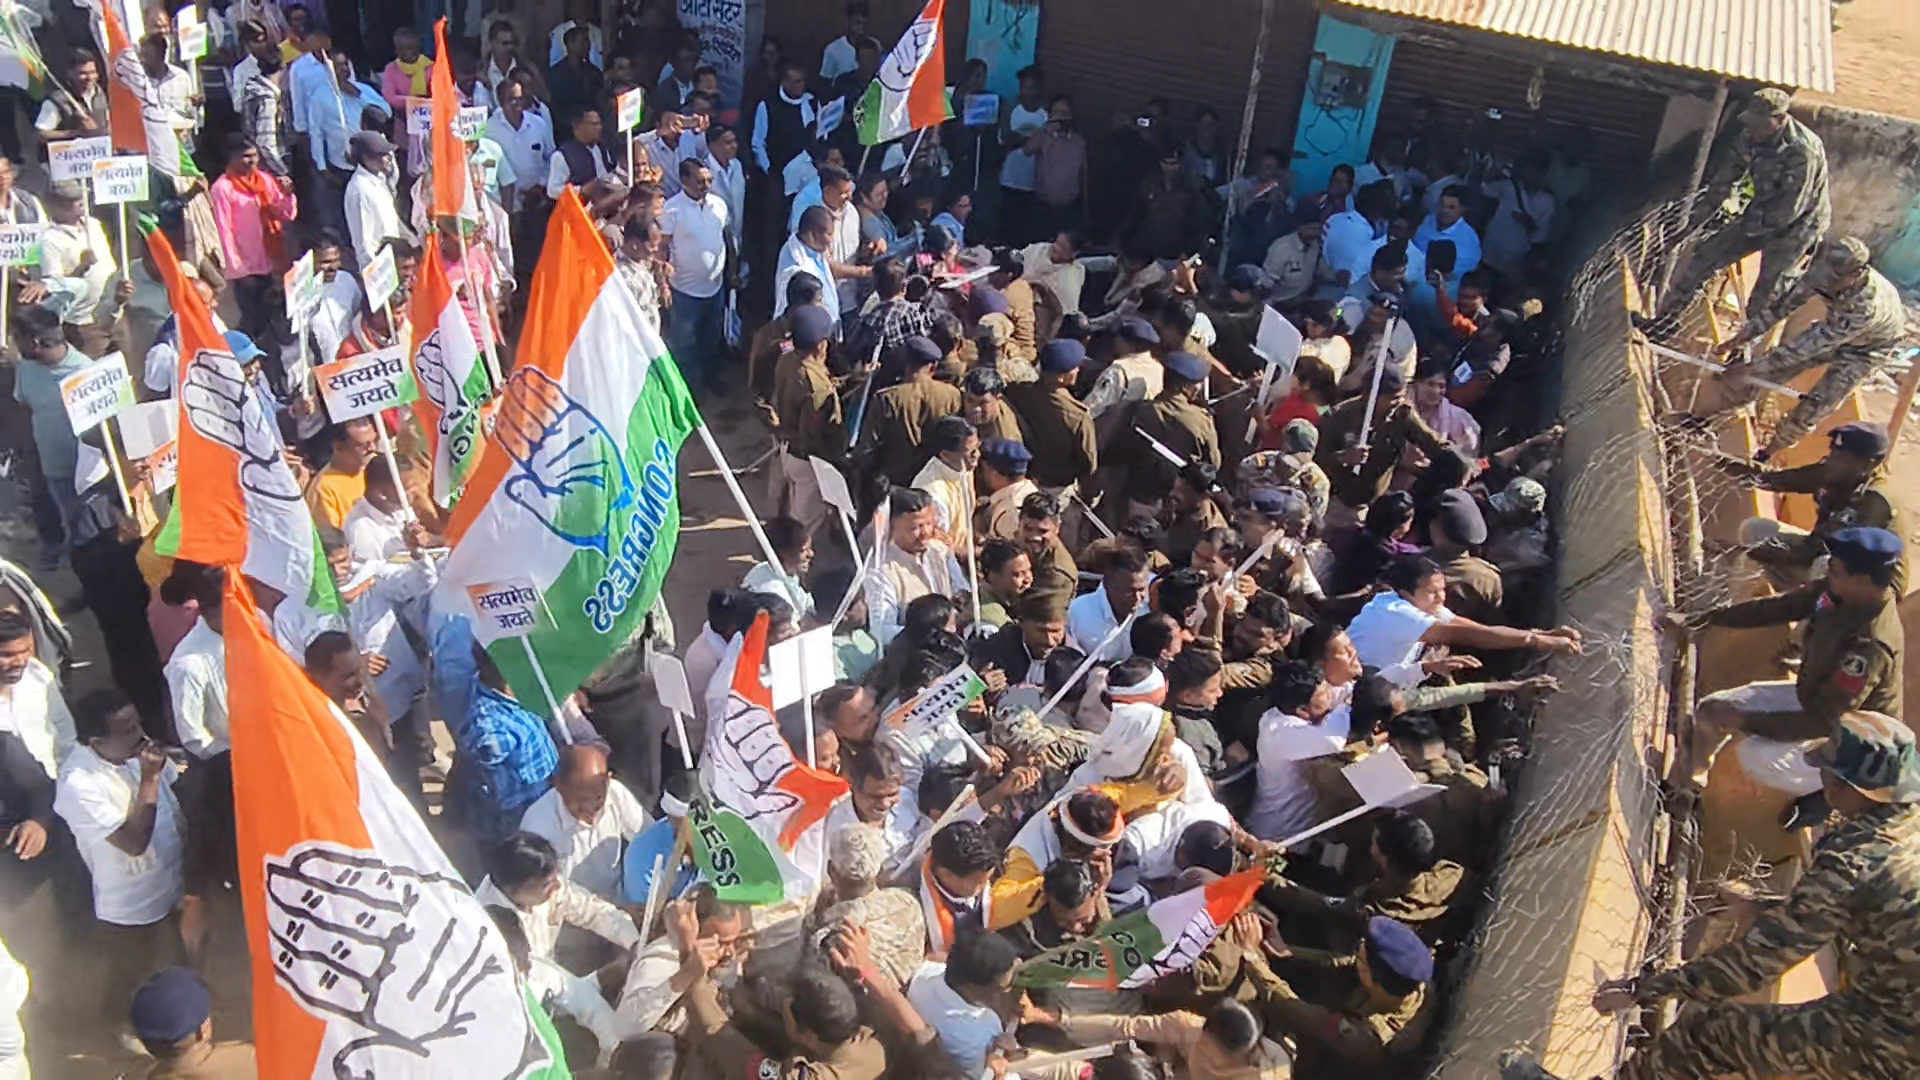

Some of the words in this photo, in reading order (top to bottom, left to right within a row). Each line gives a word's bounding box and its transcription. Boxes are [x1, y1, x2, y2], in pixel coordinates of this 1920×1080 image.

[328, 357, 404, 391] सत्यमेव
[345, 379, 398, 408] जयते
[478, 584, 537, 610] सत्यमेव
[494, 605, 535, 629] जयते
